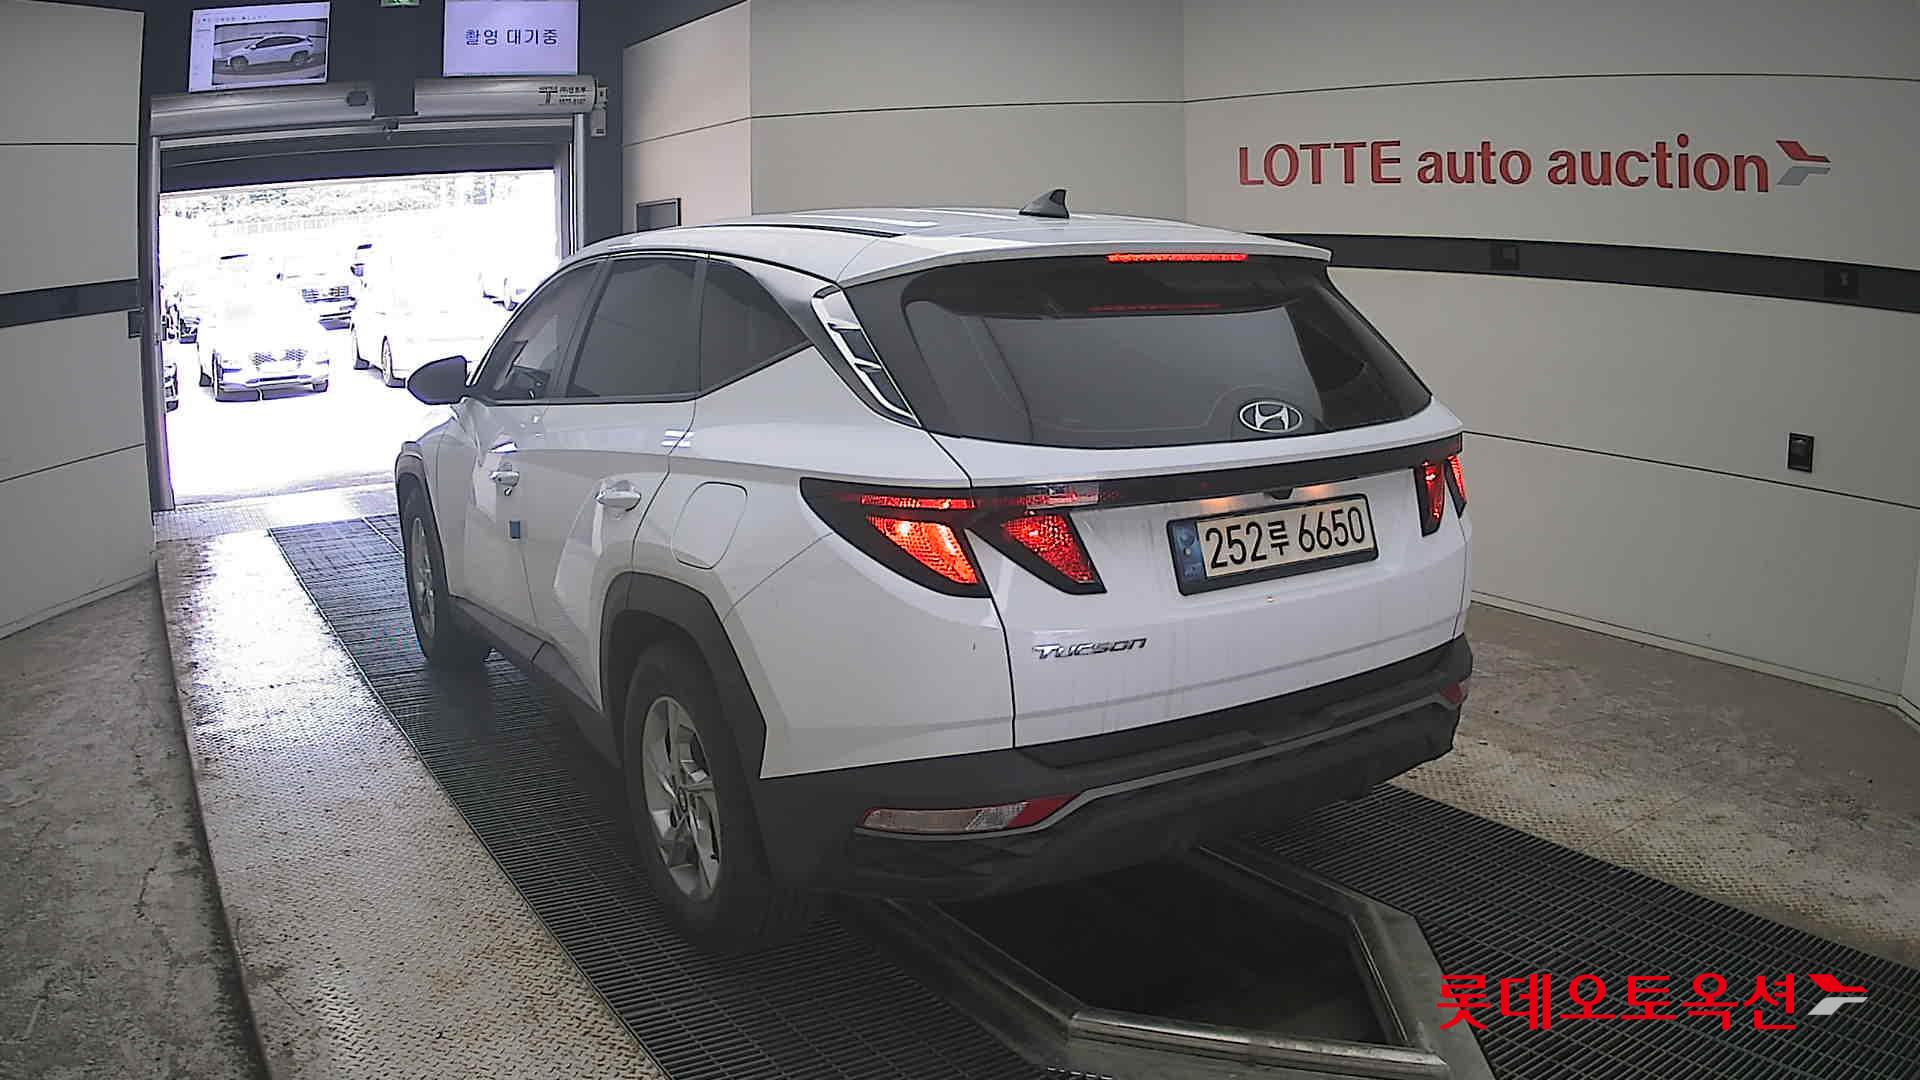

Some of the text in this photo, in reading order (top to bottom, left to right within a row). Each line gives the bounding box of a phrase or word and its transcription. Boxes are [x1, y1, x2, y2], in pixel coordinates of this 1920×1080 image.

[1239, 133, 1769, 193] LOTTE auto auction
[1205, 506, 1366, 569] 252루 6650
